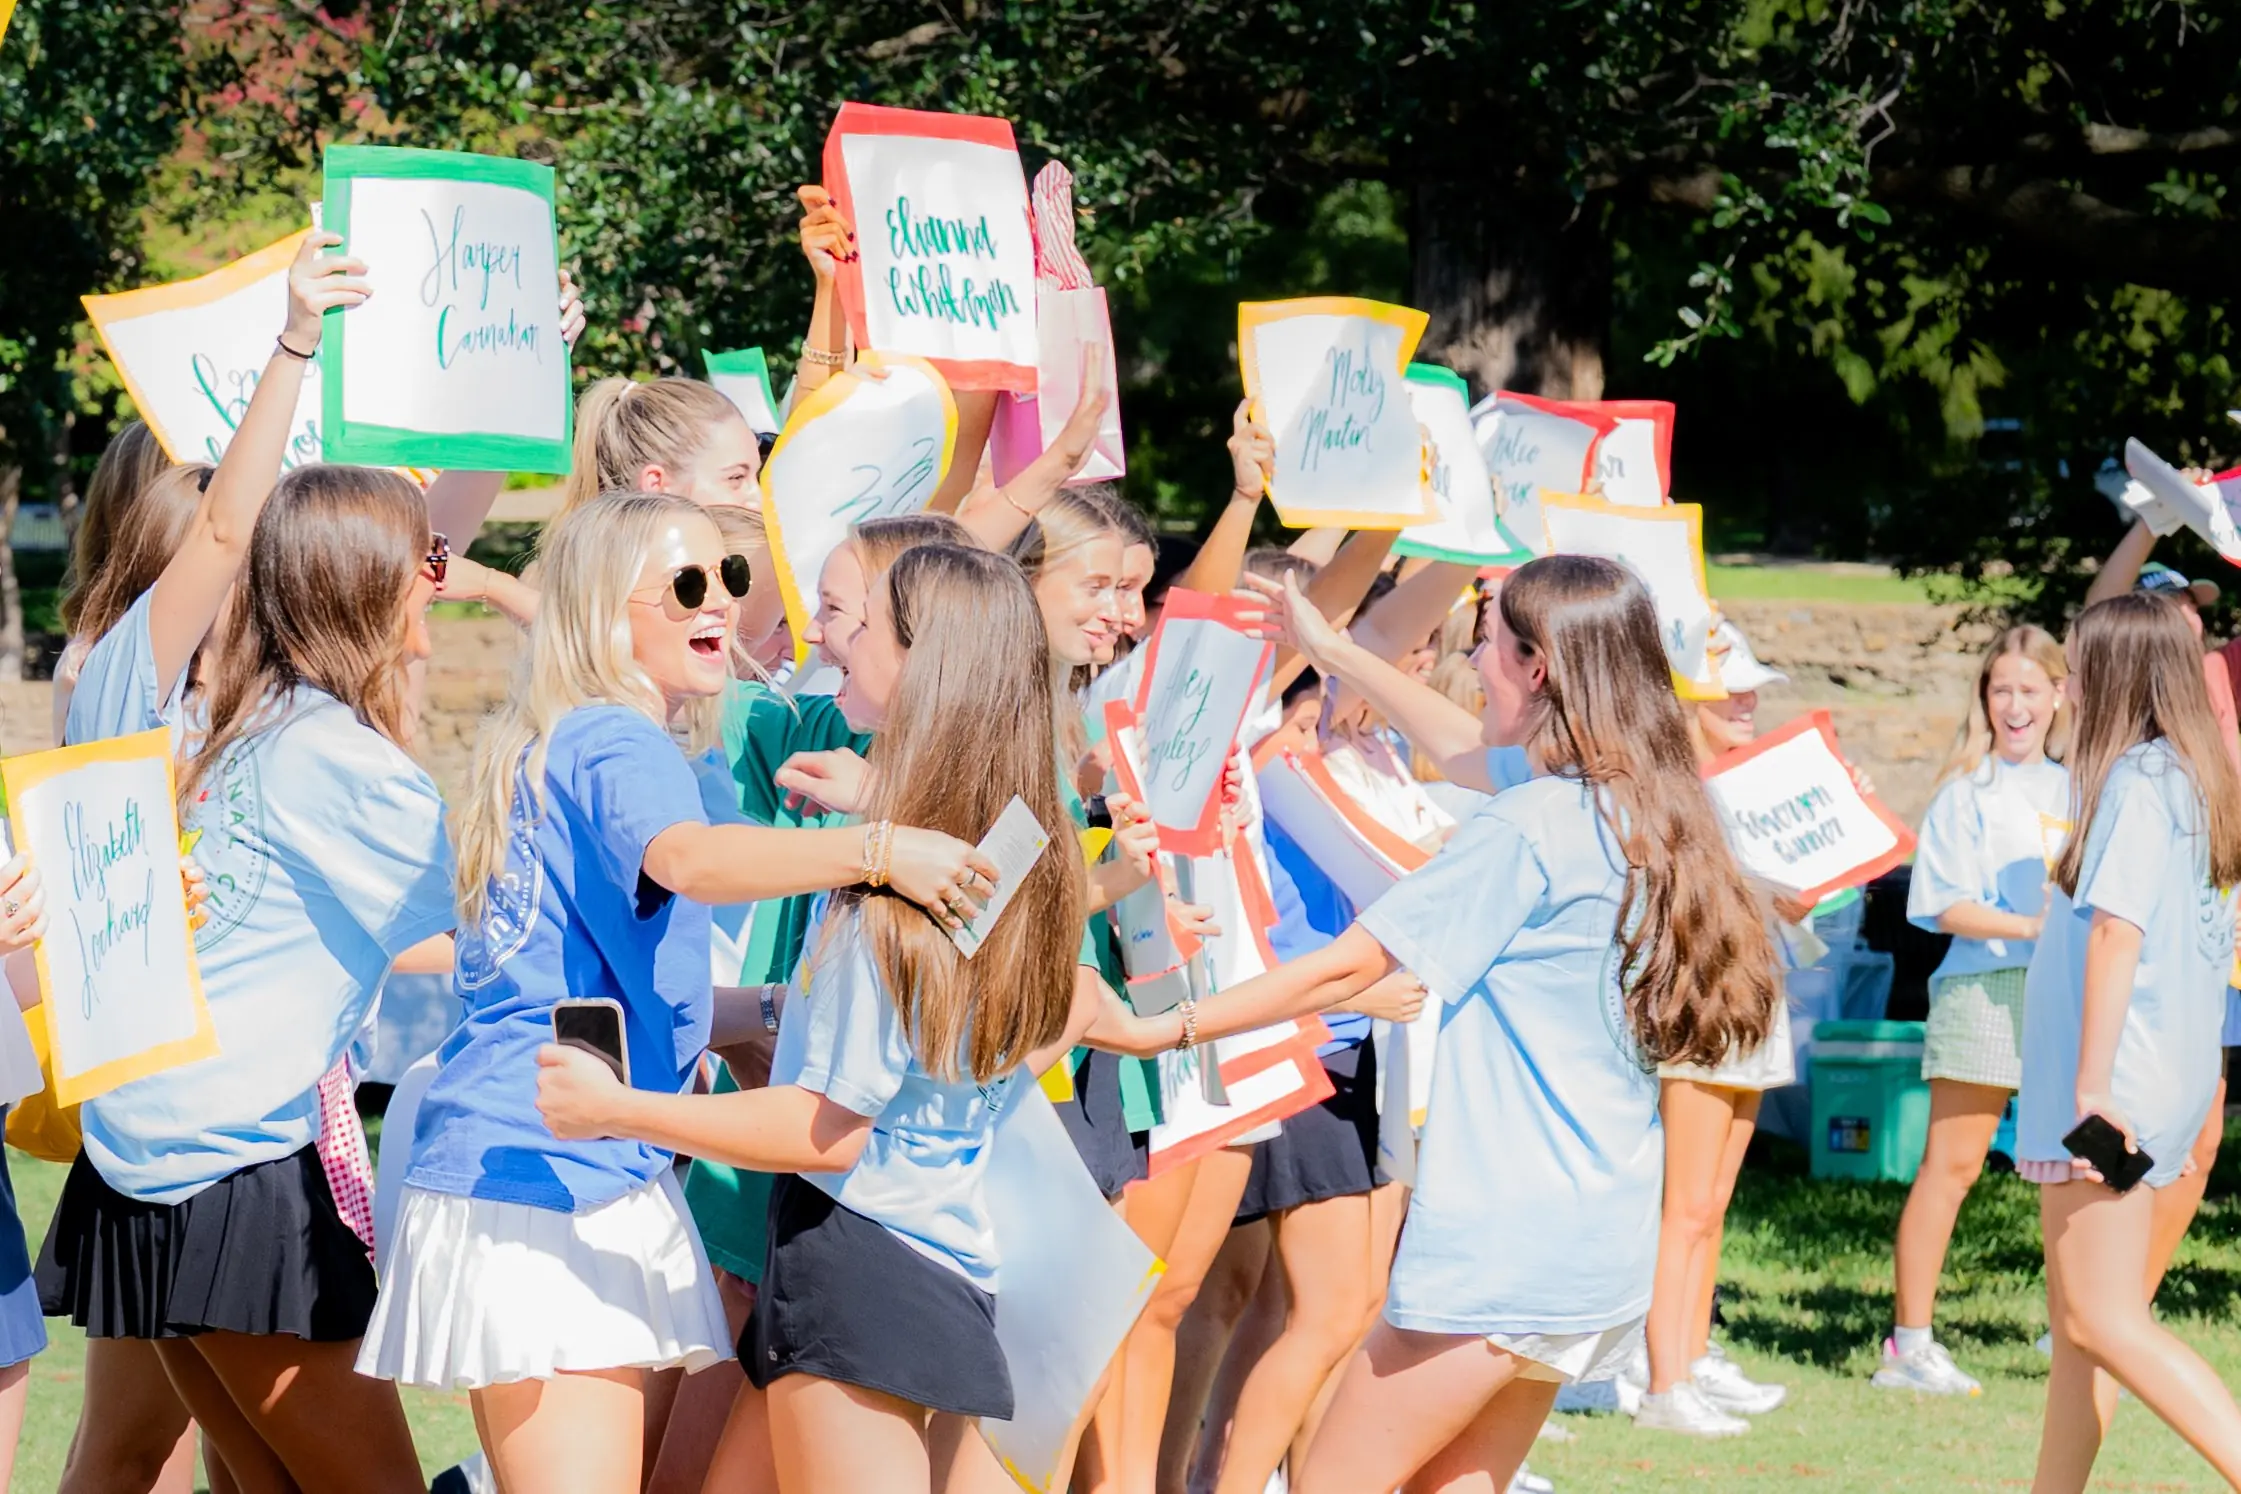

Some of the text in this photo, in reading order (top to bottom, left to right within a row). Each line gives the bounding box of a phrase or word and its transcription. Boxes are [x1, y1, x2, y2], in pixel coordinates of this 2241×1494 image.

[421, 204, 521, 311] Harper
[886, 195, 998, 260] Elianna
[1298, 405, 1373, 472] Martin
[64, 796, 149, 903] Elizabeth
